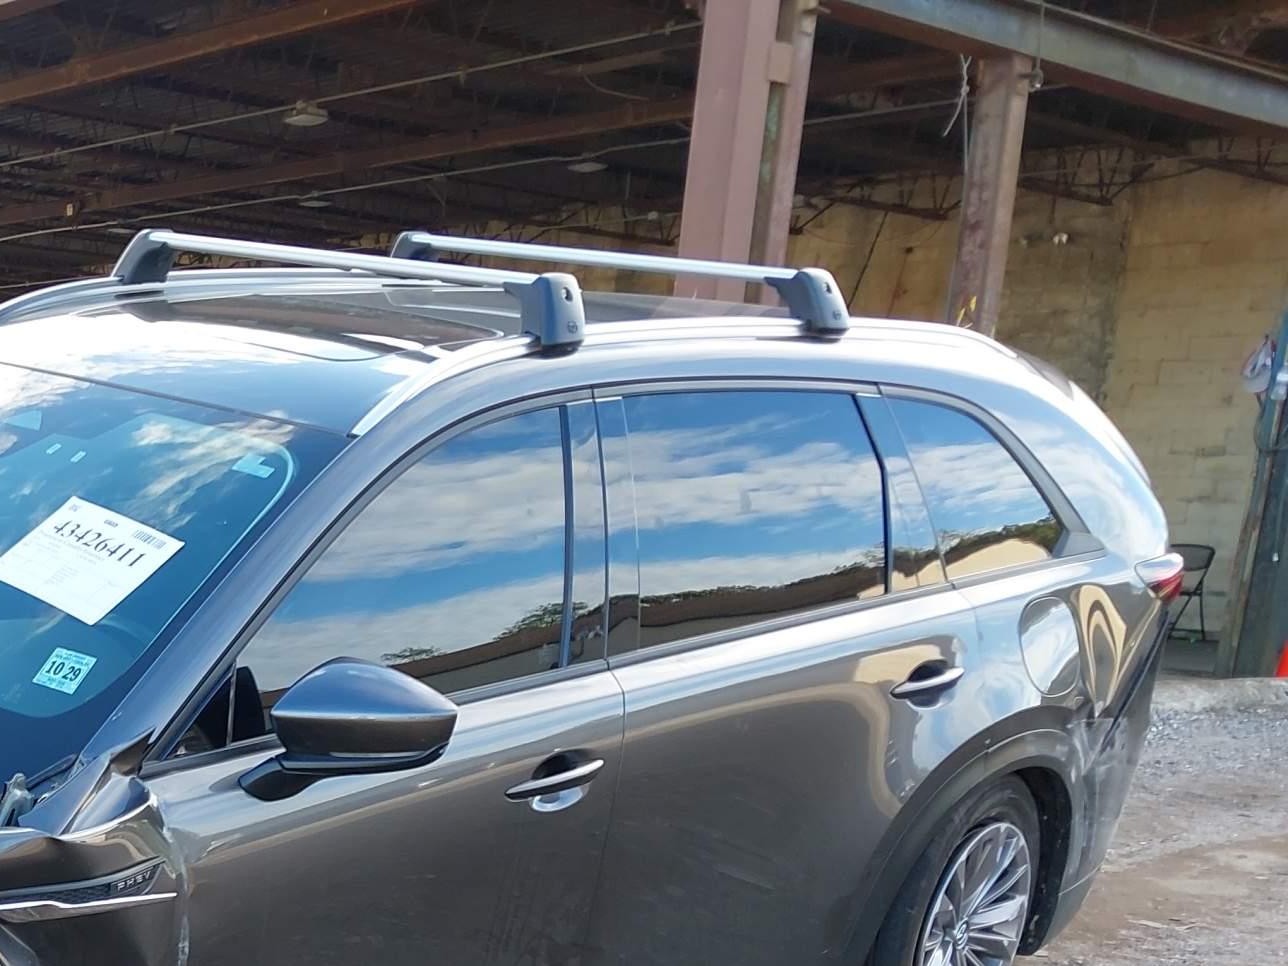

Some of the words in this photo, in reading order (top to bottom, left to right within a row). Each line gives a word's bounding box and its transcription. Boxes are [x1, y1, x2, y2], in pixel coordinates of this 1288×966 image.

[53, 519, 146, 567] 43426411
[45, 660, 65, 676] 10
[61, 665, 82, 682] 29
[117, 870, 152, 891] PHEV
